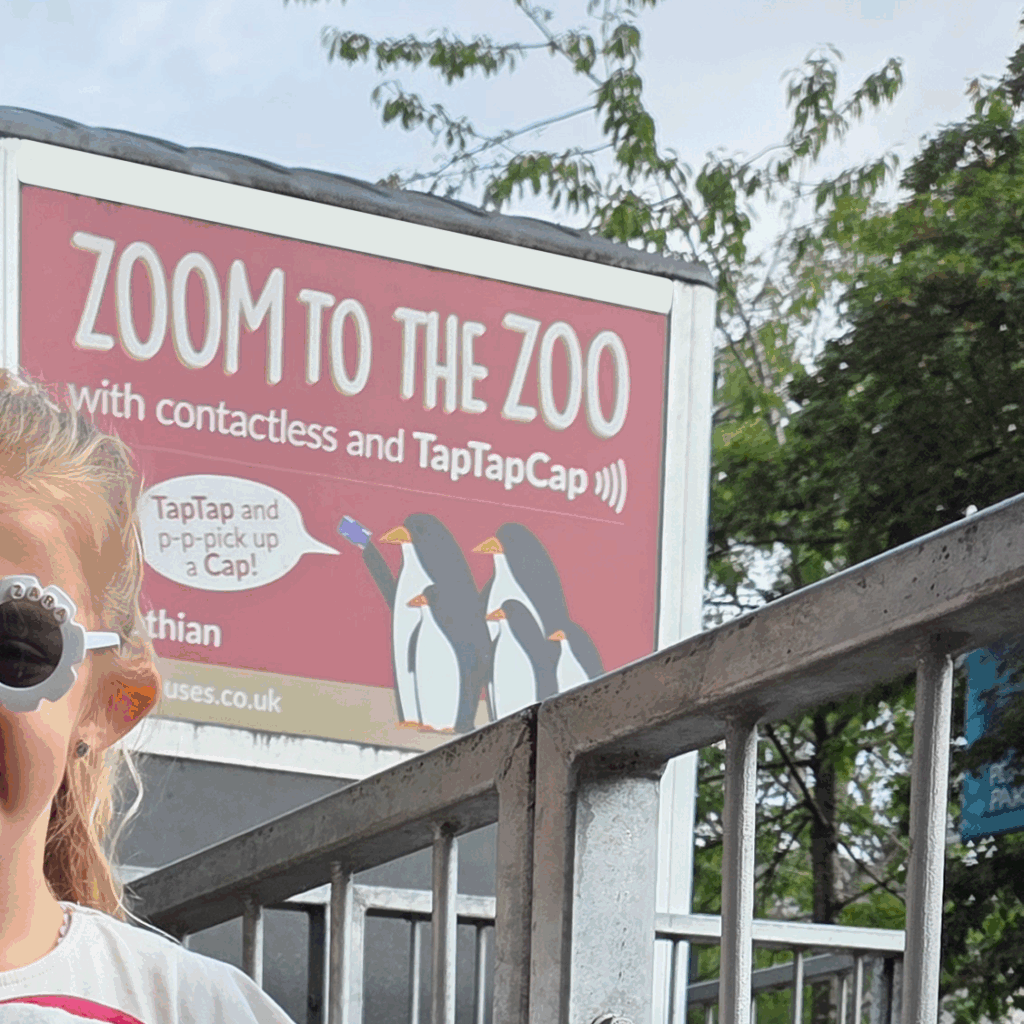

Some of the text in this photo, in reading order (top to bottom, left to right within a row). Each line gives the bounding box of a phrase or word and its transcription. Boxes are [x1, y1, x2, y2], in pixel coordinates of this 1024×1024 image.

[71, 231, 630, 438] ZOOM TO THE ZOO
[67, 378, 589, 500] with contactless and TapTapCap
[151, 495, 279, 525] TapTap and
[158, 526, 279, 553] p-p-pick up
[185, 553, 258, 582] a Cap!
[12, 583, 67, 622] ZARA
[146, 608, 221, 648] thian
[163, 680, 282, 714] uses.co.uk
